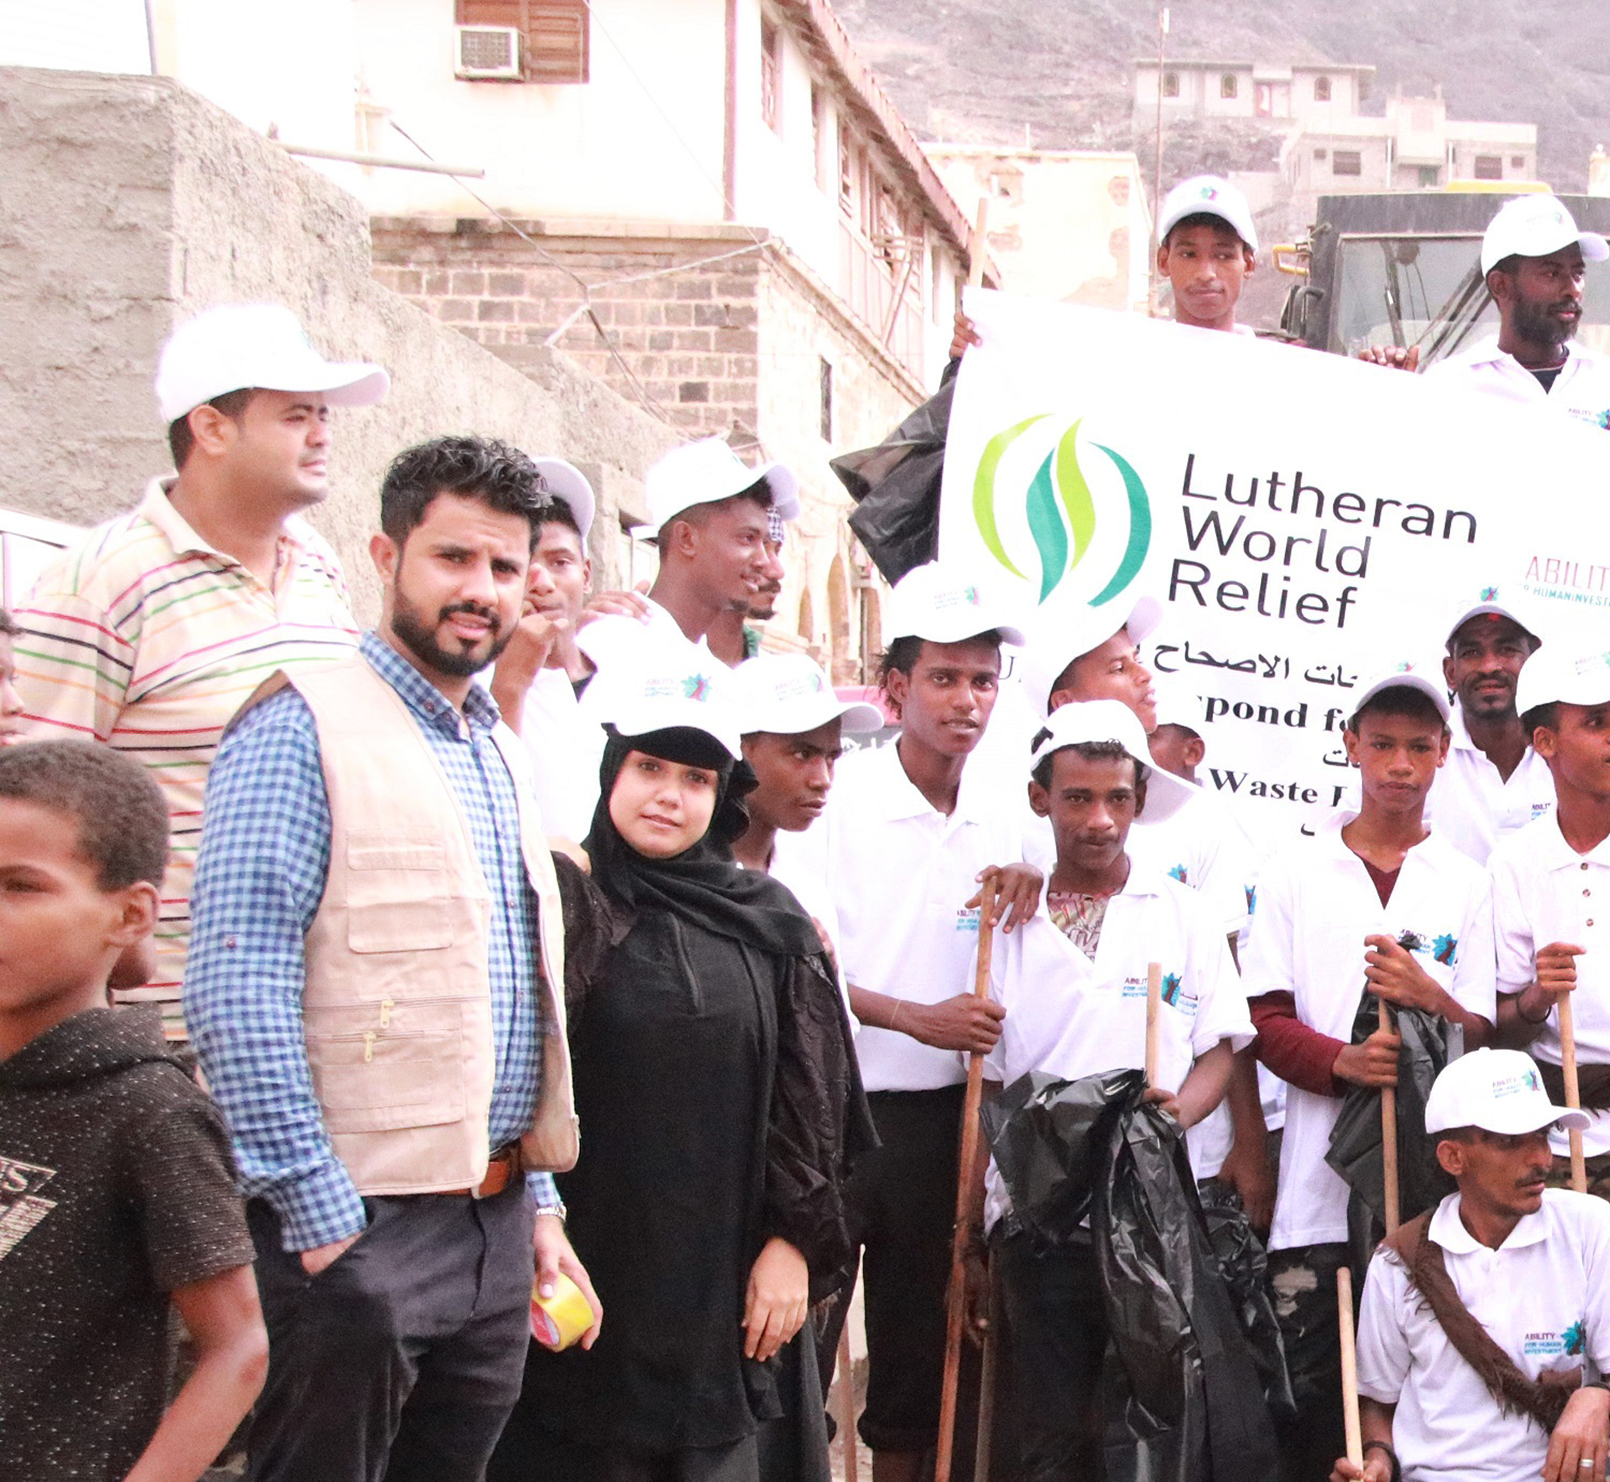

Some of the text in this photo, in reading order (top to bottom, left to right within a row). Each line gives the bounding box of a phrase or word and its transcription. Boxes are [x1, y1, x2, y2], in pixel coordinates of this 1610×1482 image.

[1181, 454, 1477, 543] Lutheran
[1181, 506, 1372, 579] World
[1168, 560, 1357, 628] Relief
[1196, 694, 1309, 729] pond
[1208, 768, 1318, 804] Waste
[1525, 1332, 1556, 1341] ABILITY
